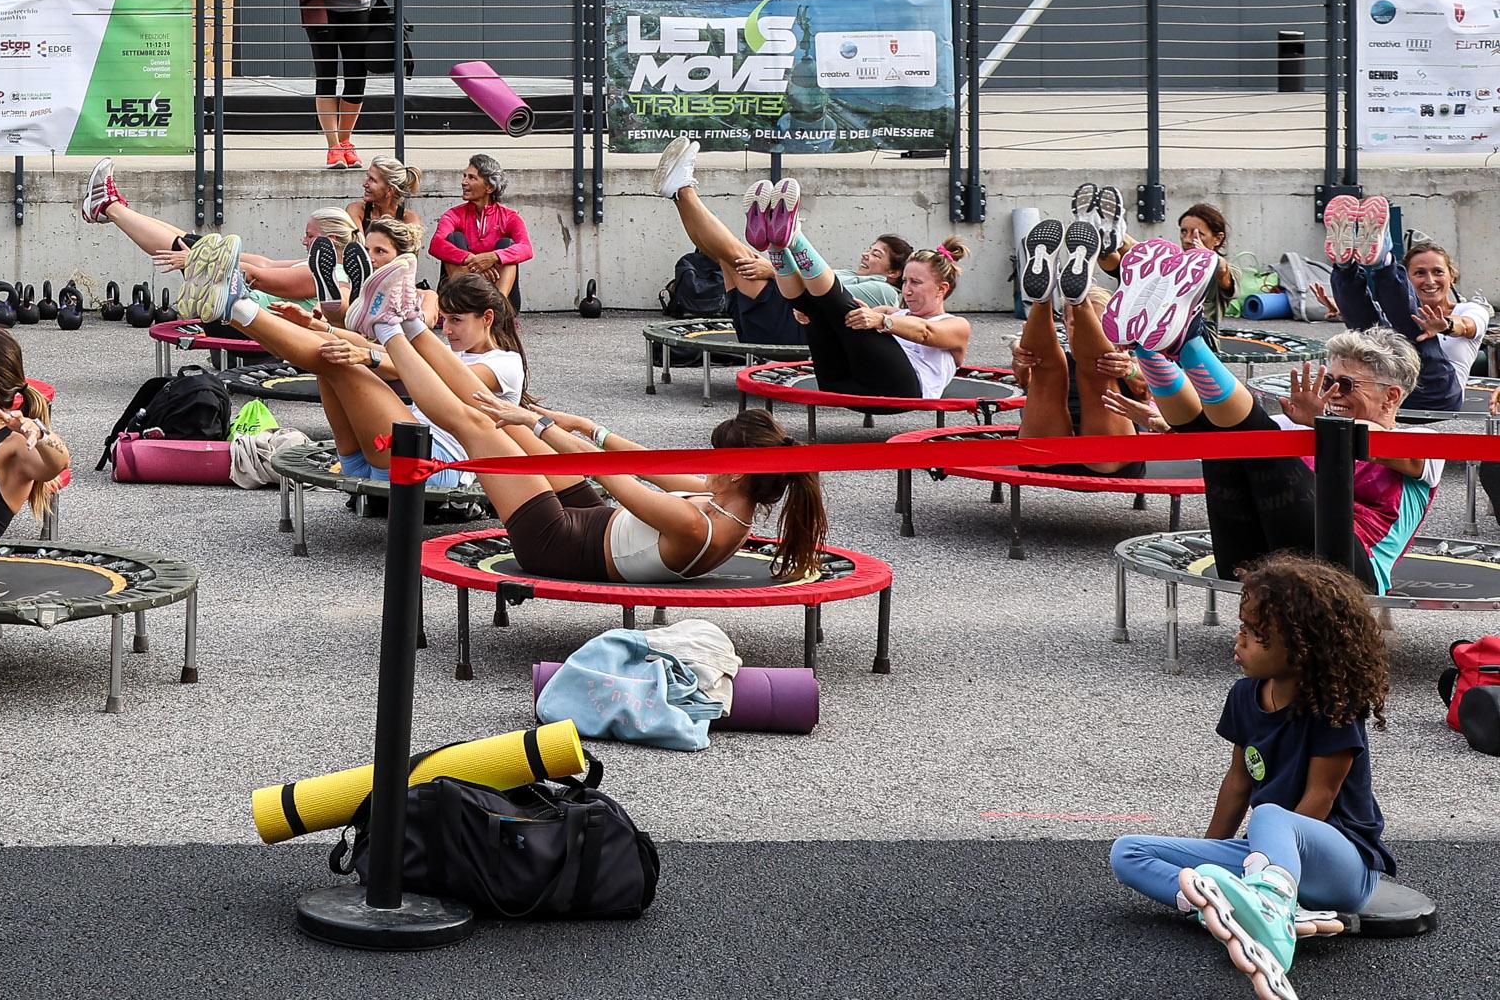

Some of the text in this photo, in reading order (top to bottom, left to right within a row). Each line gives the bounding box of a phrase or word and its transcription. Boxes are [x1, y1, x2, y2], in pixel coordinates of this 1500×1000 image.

[48, 45, 72, 53] EDGE
[1368, 40, 1400, 48] creativa
[627, 55, 794, 93] MOVE
[1368, 70, 1398, 80] GENIUS
[628, 94, 786, 117] TRIESTE
[107, 113, 172, 127] MOVE
[105, 129, 167, 137] TRIESTE
[627, 127, 935, 140] FESTIVAL DEL FITNESS, DELLA SALUTE E DEL BENESSERE
